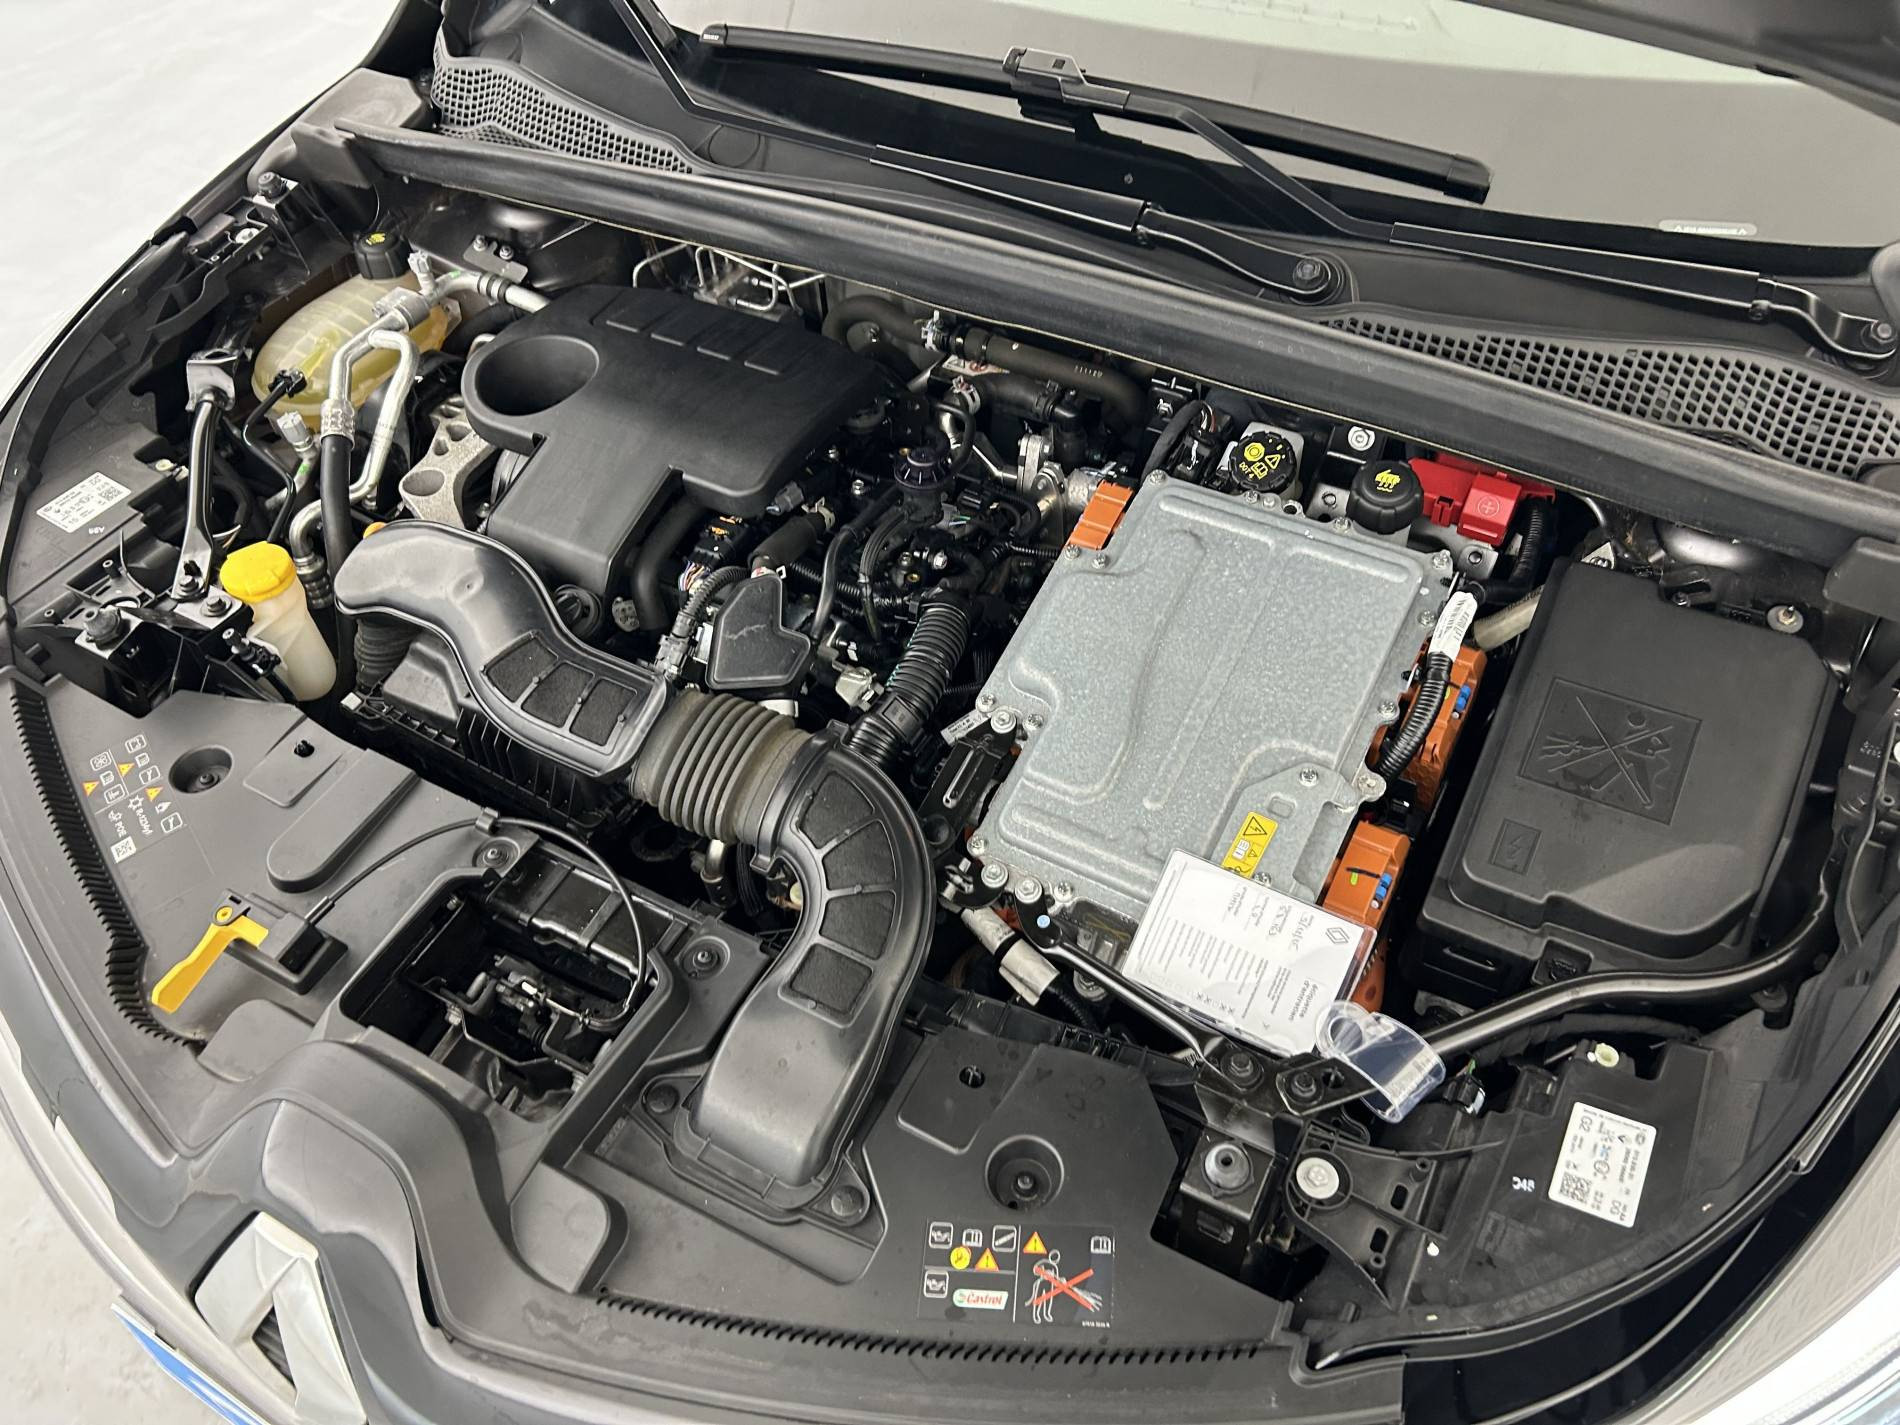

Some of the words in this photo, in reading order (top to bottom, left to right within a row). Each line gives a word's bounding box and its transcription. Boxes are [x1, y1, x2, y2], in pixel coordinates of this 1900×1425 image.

[1239, 461, 1251, 474] DOT
[115, 821, 127, 838] POE
[966, 1292, 1003, 1307] Castrol
